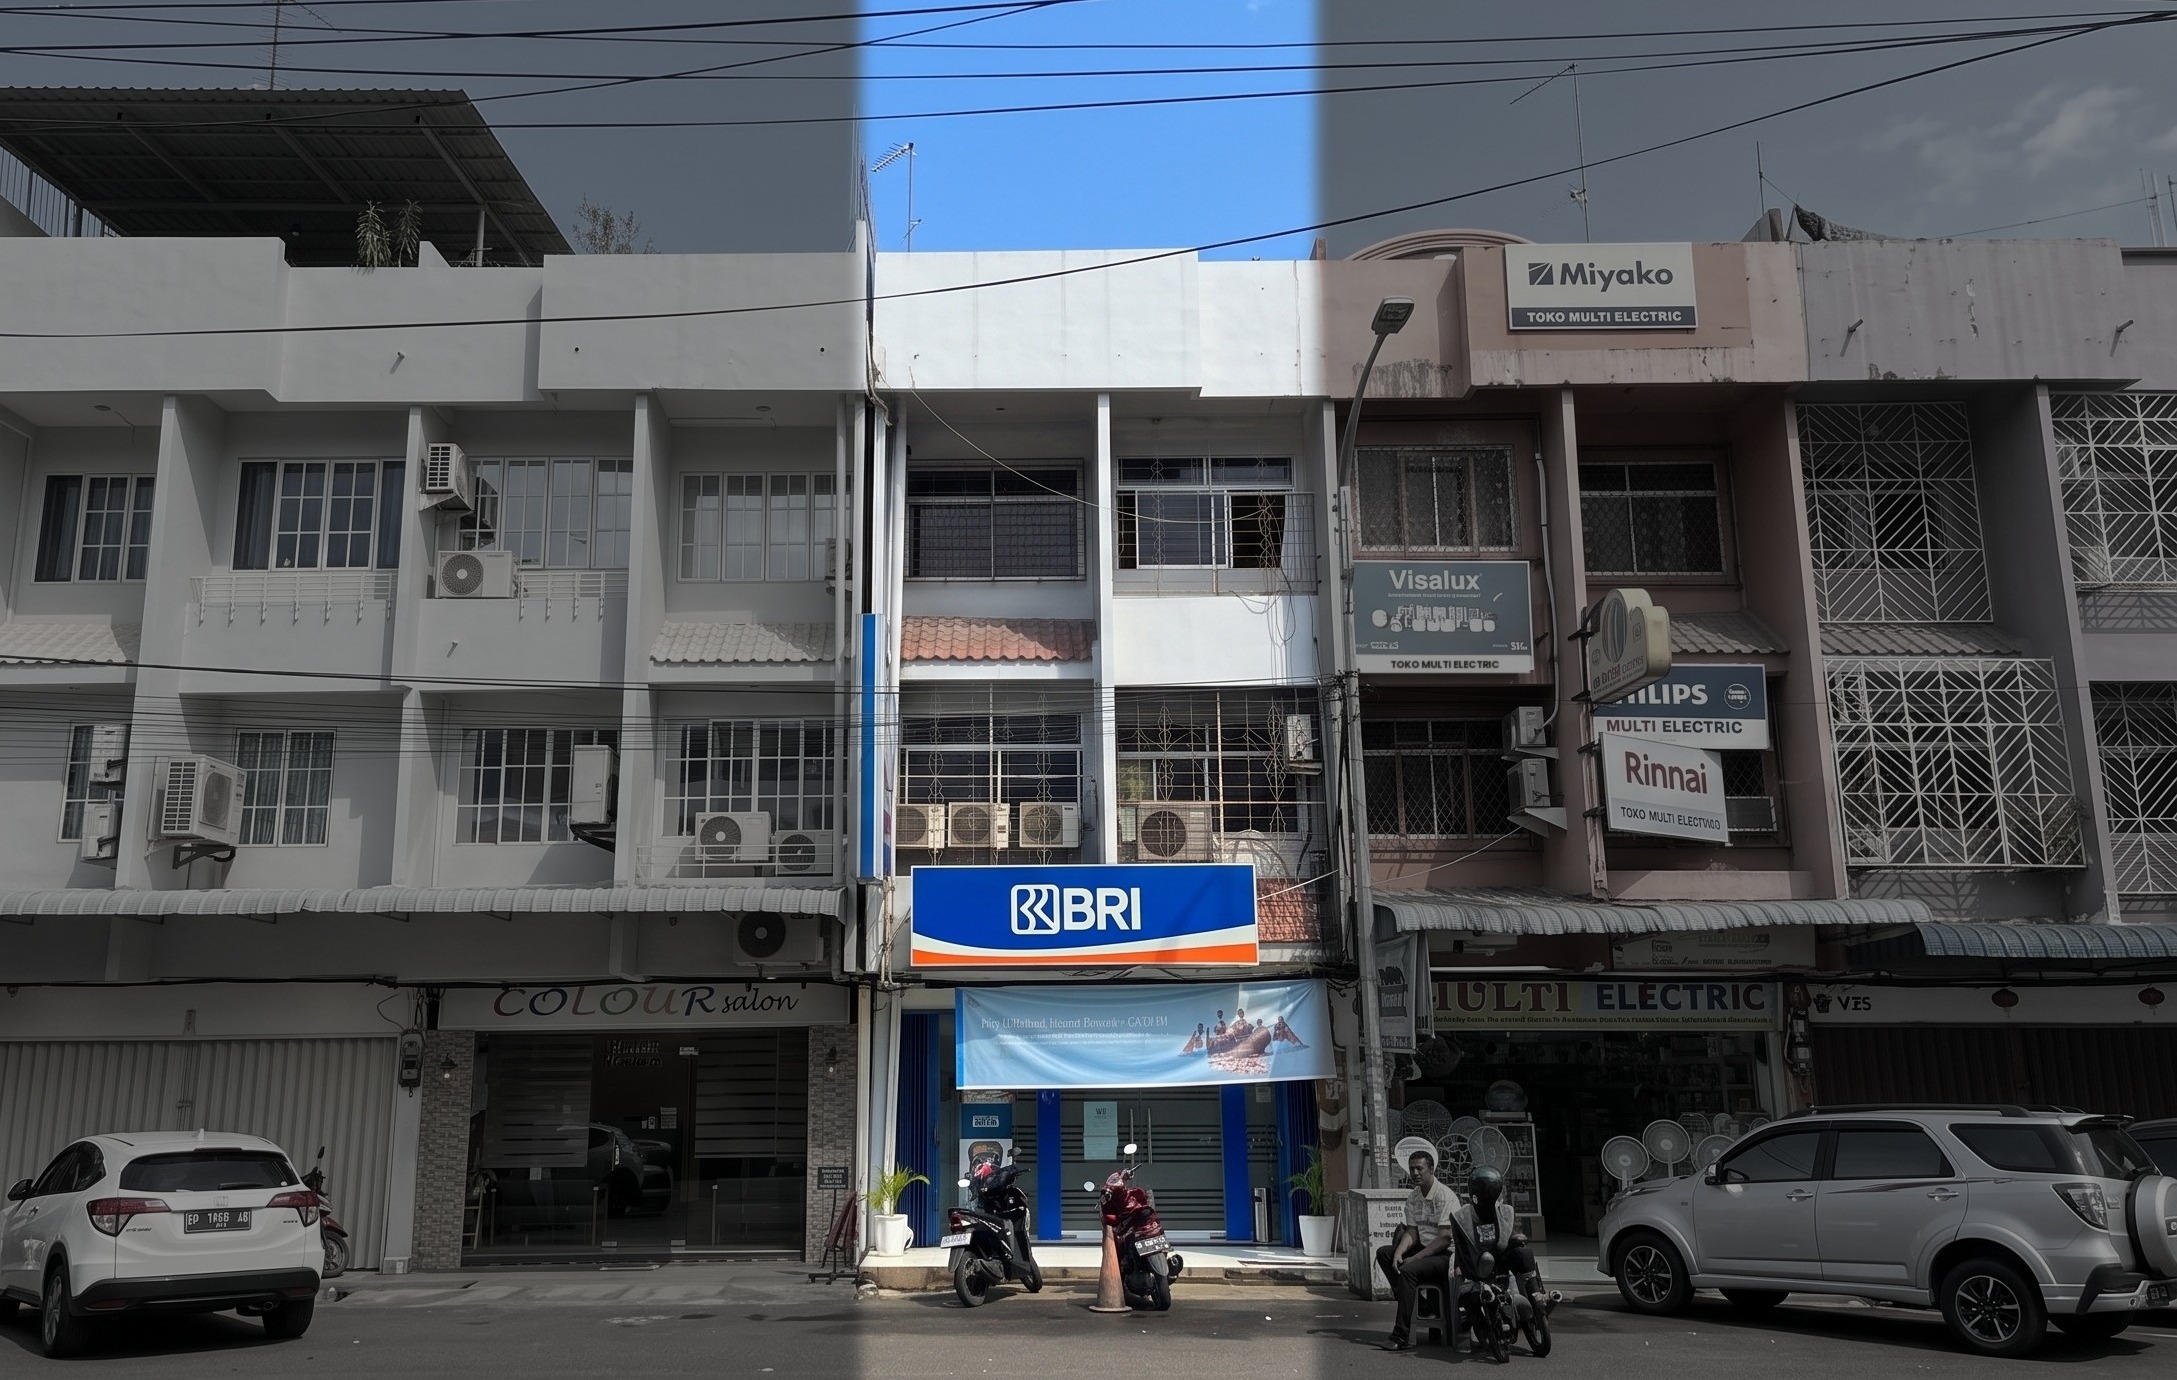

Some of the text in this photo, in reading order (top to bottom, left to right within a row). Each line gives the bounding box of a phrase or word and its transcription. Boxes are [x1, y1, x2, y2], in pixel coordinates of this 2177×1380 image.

[1560, 260, 1674, 292] Miyako
[1526, 310, 1682, 323] TOKO MULTI ELECTRIC
[1388, 569, 1480, 590] Visalux
[1390, 660, 1500, 670] TOKO MULTI ELECTRIC
[1606, 719, 1743, 734] MULTI ELECTRIC
[1624, 750, 1708, 795] Rinnai
[1648, 810, 1675, 824] MULTI
[1063, 887, 1141, 930] BRI
[493, 985, 799, 1017] COLOUR salon
[1596, 983, 1765, 1012] ELECTRIC
